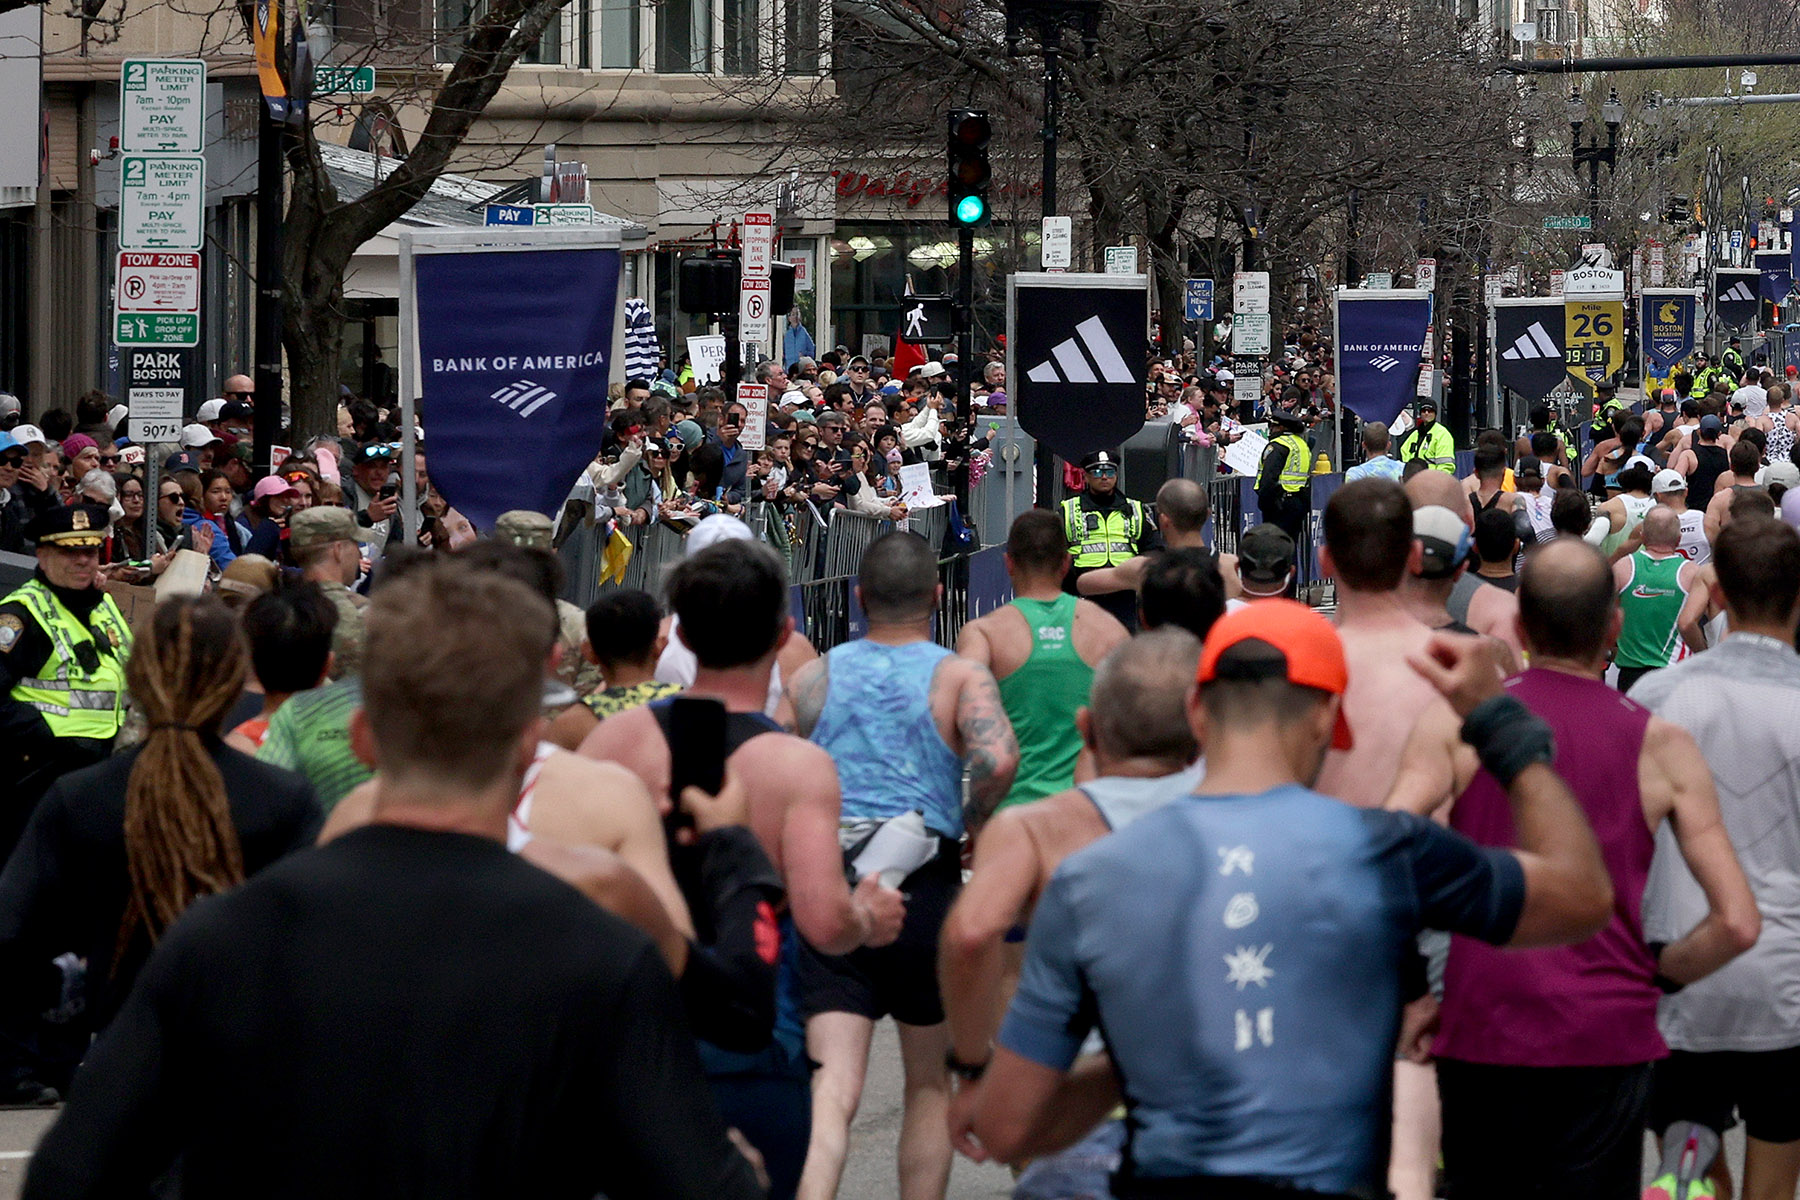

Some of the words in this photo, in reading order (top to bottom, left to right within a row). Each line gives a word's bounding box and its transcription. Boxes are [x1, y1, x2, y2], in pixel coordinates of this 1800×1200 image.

[128, 64, 144, 82] 2
[357, 80, 367, 90] ST
[136, 95, 154, 104] 7am
[166, 96, 191, 105] 10pm
[150, 115, 176, 124] PAY
[127, 160, 144, 178] 2
[136, 192, 158, 200] 7am
[168, 192, 190, 201] 4pm
[149, 211, 175, 220] PAY
[499, 209, 521, 221] PAY
[537, 208, 549, 222] 2
[125, 255, 154, 265] TOW
[158, 255, 193, 266] ZONE
[1107, 251, 1114, 260] 2
[1573, 271, 1613, 280] BOSTON
[1235, 315, 1243, 324] 2
[1572, 313, 1613, 337] 26
[133, 354, 180, 368] PARK
[434, 358, 486, 372] BANK
[493, 357, 518, 370] OF
[522, 351, 603, 369] AMERICA
[133, 369, 180, 380] BOSTON
[143, 426, 167, 439] 907
